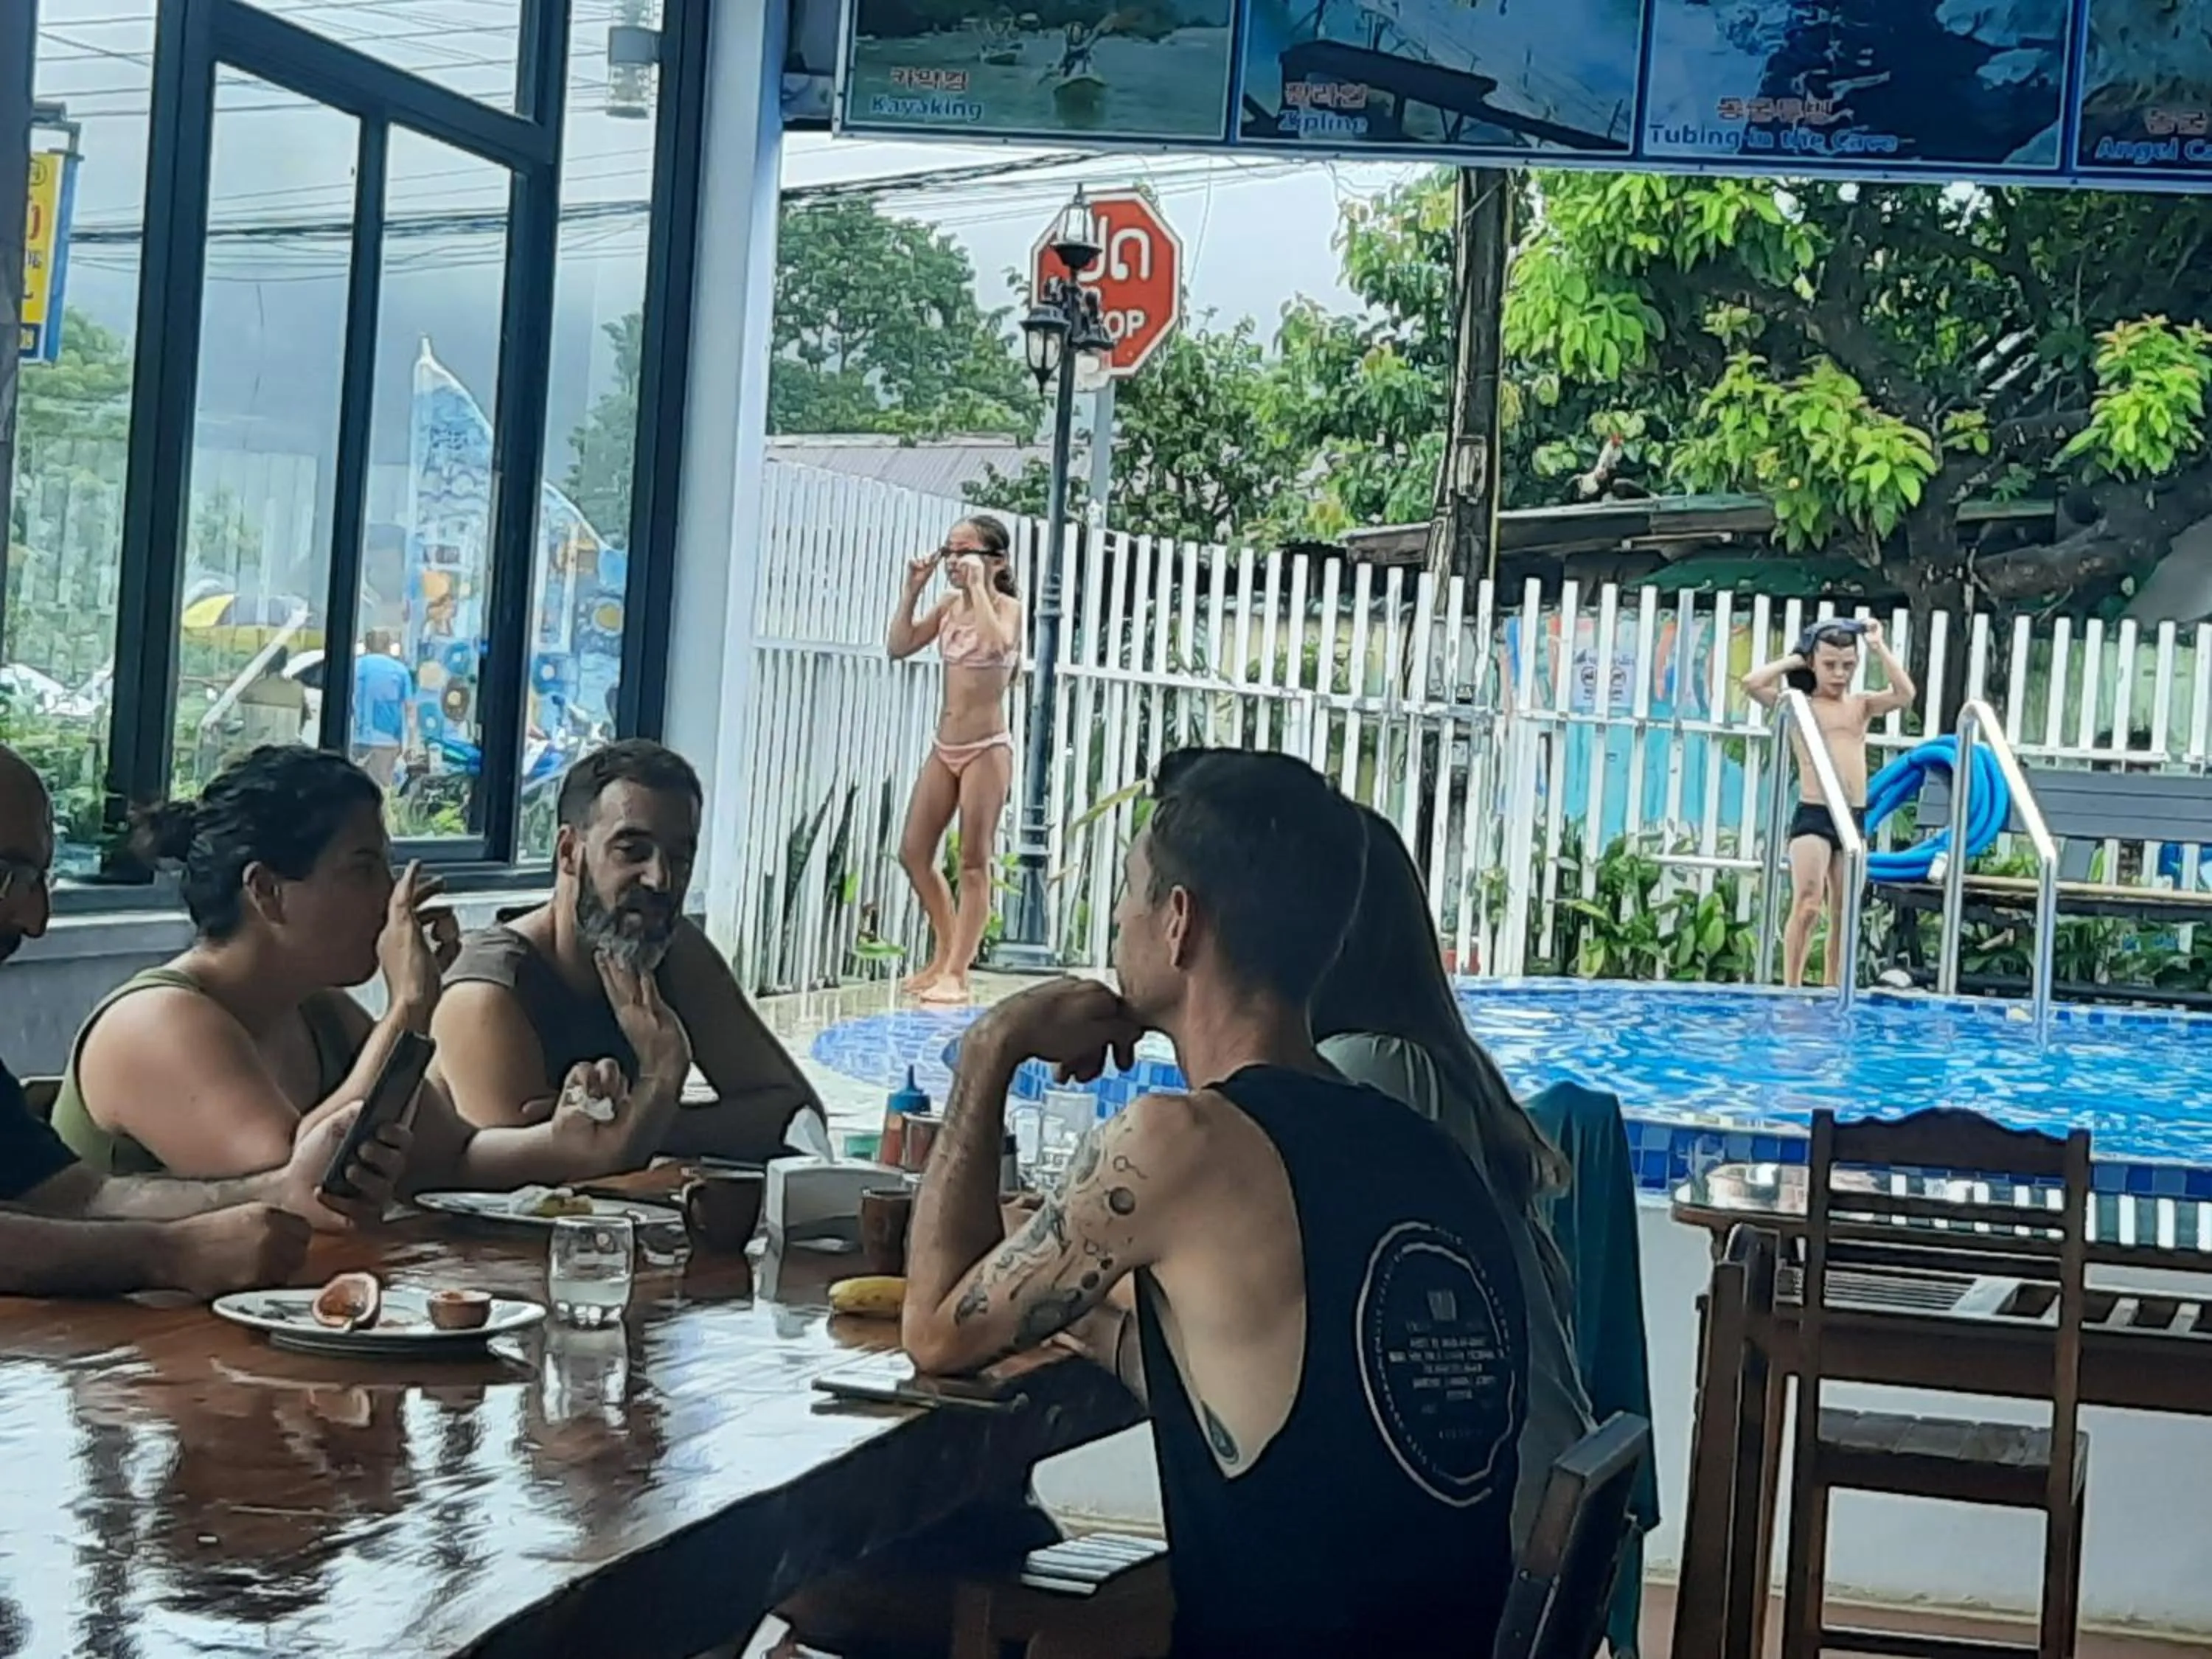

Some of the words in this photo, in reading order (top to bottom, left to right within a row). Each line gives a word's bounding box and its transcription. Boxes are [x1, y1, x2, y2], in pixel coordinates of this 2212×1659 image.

[872, 95, 983, 122] Kayaking
[1649, 123, 1741, 150] Tubing
[1747, 126, 1774, 147] in
[1780, 128, 1826, 150] the
[1832, 129, 1898, 153] Cave
